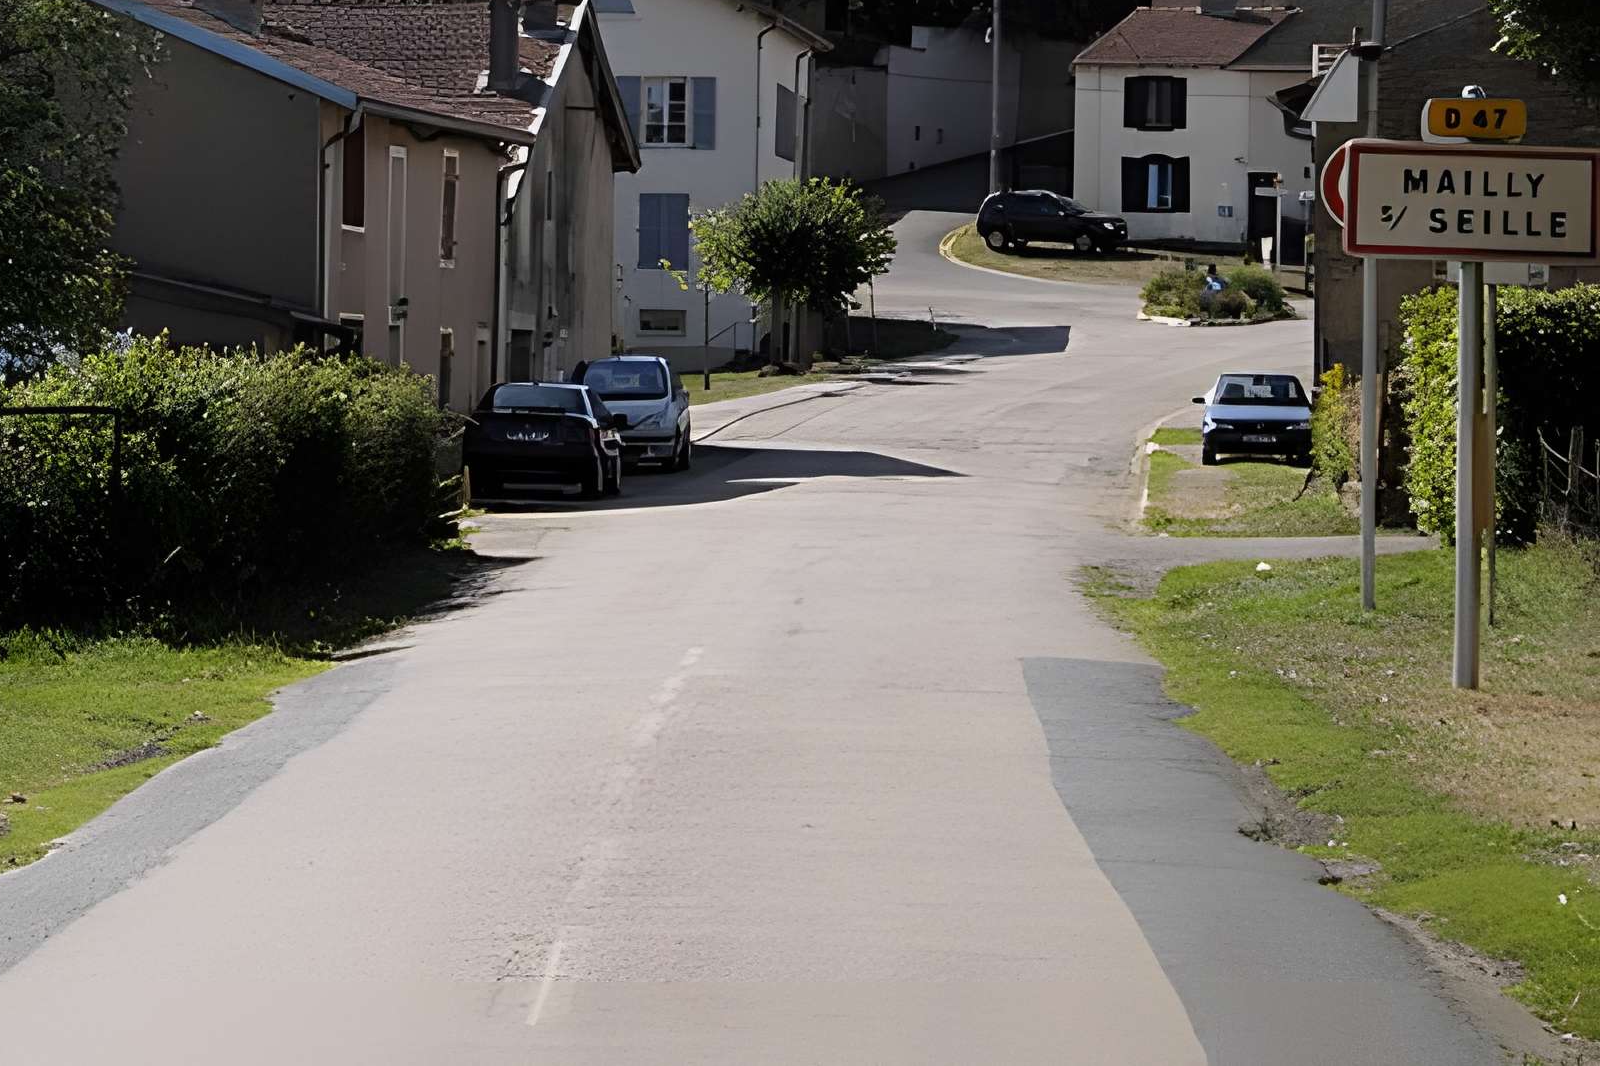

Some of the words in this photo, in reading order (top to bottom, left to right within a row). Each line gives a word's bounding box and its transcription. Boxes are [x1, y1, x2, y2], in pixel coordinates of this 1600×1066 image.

[1445, 108, 1461, 129] D
[1472, 108, 1508, 129] 47
[1403, 168, 1545, 199] MAILLY
[1428, 207, 1567, 239] SEILLE
